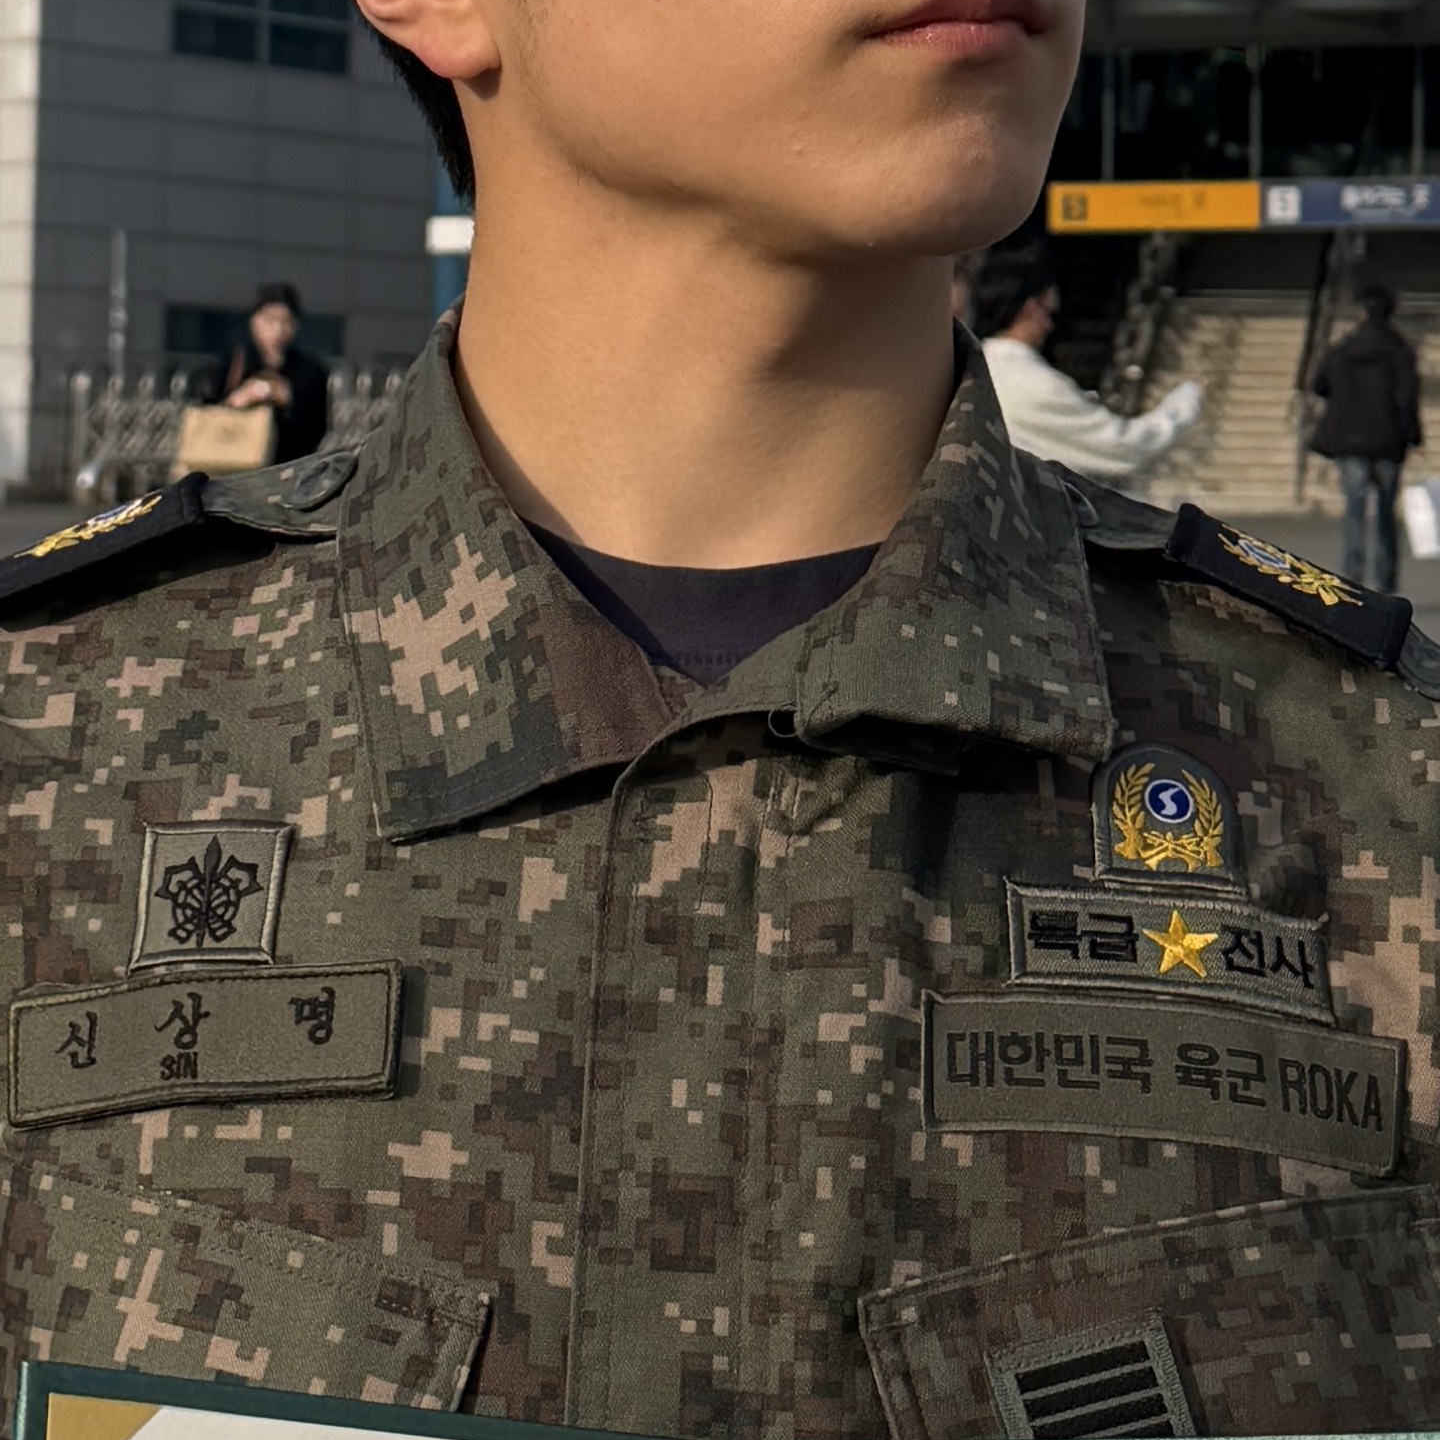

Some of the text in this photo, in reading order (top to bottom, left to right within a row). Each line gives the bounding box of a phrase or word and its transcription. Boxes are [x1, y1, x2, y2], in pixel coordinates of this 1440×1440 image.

[1028, 910, 1315, 989] 특급 전사
[946, 1031, 1383, 1132] 대한민국 육군 ROKA
